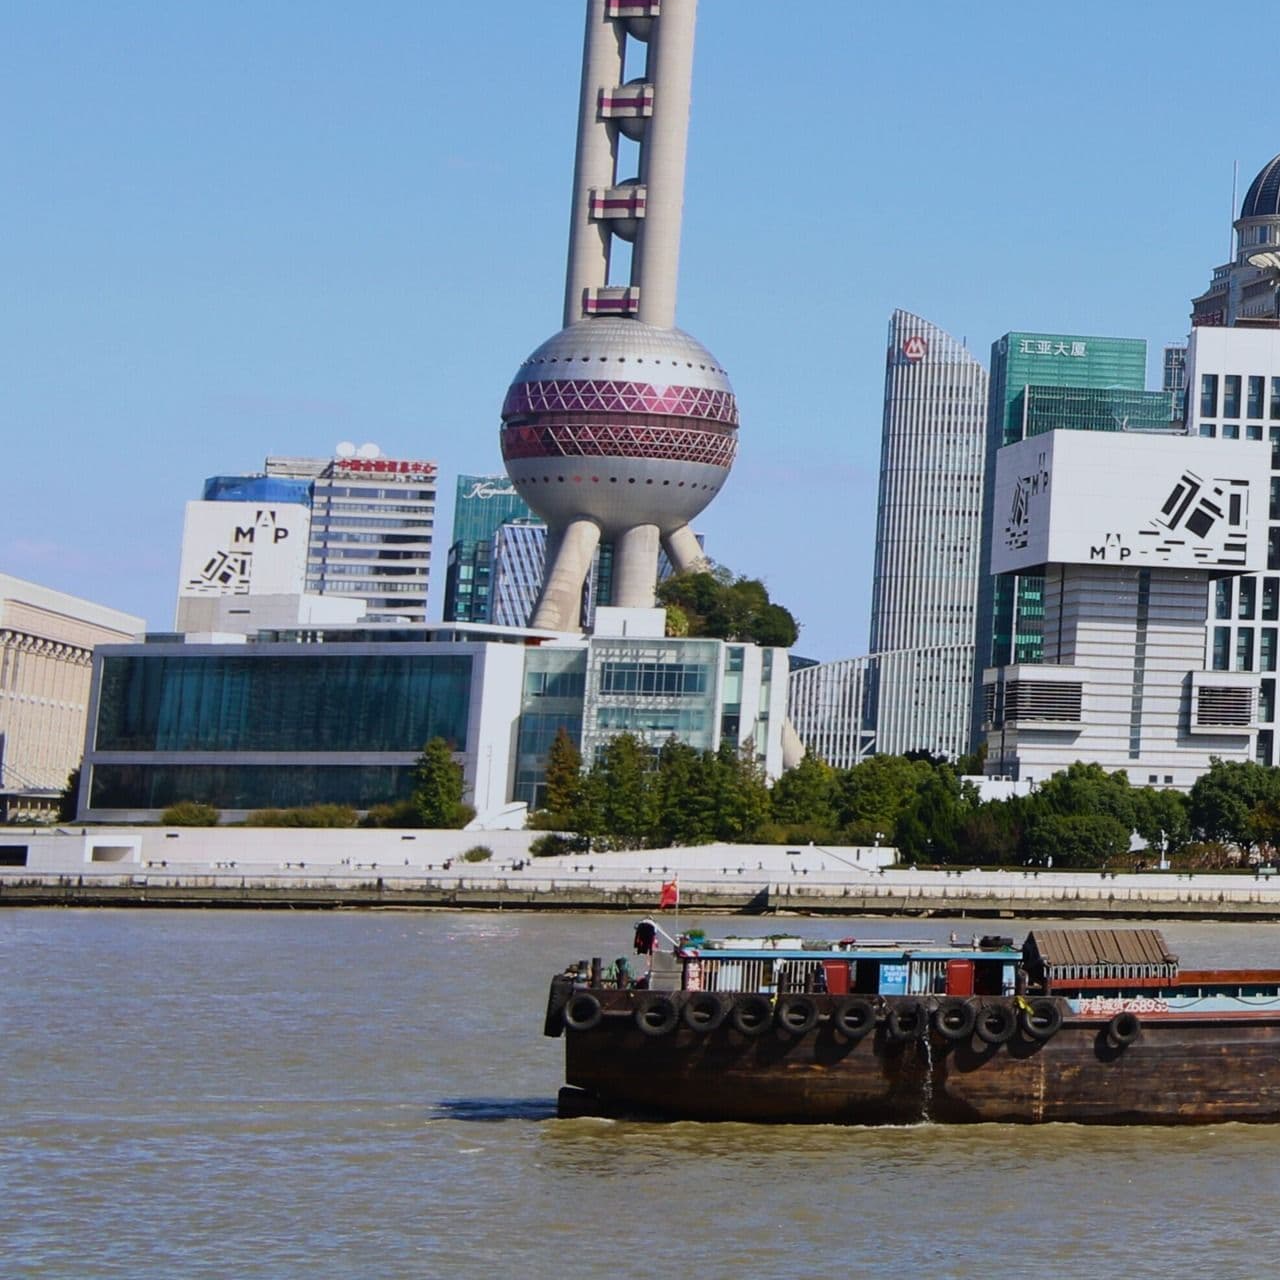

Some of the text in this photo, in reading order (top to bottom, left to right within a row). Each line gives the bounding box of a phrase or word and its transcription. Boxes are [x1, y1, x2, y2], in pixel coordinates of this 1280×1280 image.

[1020, 339, 1088, 358] 汇亚大厦
[234, 510, 289, 544] MAP
[1089, 533, 1132, 561] MAP
